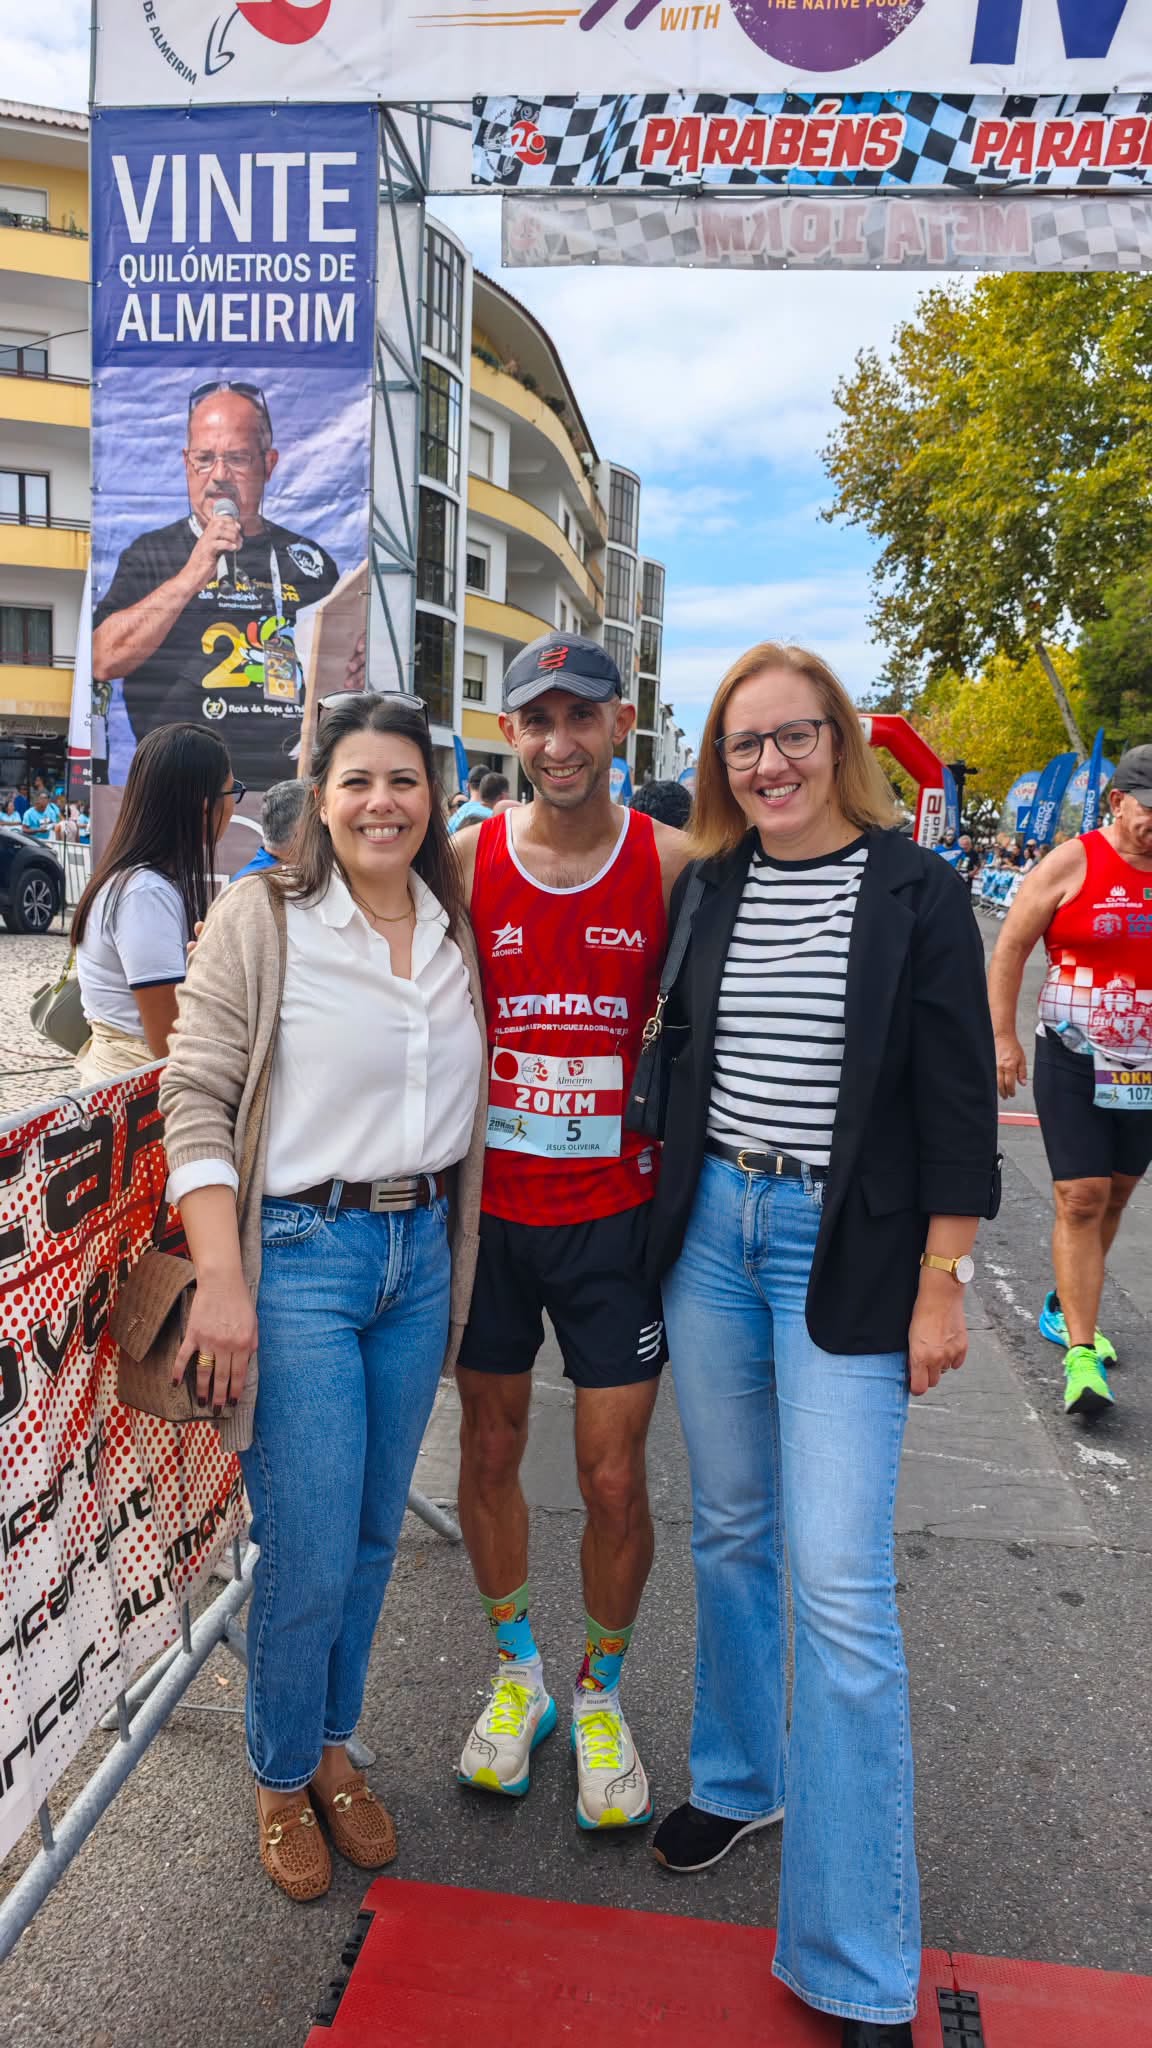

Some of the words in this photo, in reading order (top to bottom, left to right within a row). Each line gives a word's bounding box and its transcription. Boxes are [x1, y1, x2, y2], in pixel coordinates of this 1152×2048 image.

[143, 0, 157, 22] DE
[660, 4, 720, 31] WITH
[803, 0, 860, 10] NATIVE
[149, 26, 197, 85] ALMEIRIM
[639, 100, 904, 174] PARABÉNS
[970, 115, 1152, 174] PARAB
[111, 151, 357, 244] VINTE
[119, 247, 311, 289] QUILÓMETROS
[320, 253, 355, 282] DE
[116, 292, 355, 343] ALMEIRIM
[585, 926, 643, 948] CDM
[491, 947, 523, 957] ARONICK
[497, 993, 629, 1019] AZINHAGA
[558, 1076, 593, 1085] Almeirim
[515, 1087, 596, 1114] 20KM
[1127, 1087, 1152, 1101] 107
[566, 1119, 582, 1142] 5
[568, 1143, 600, 1151] OLIVEIRA
